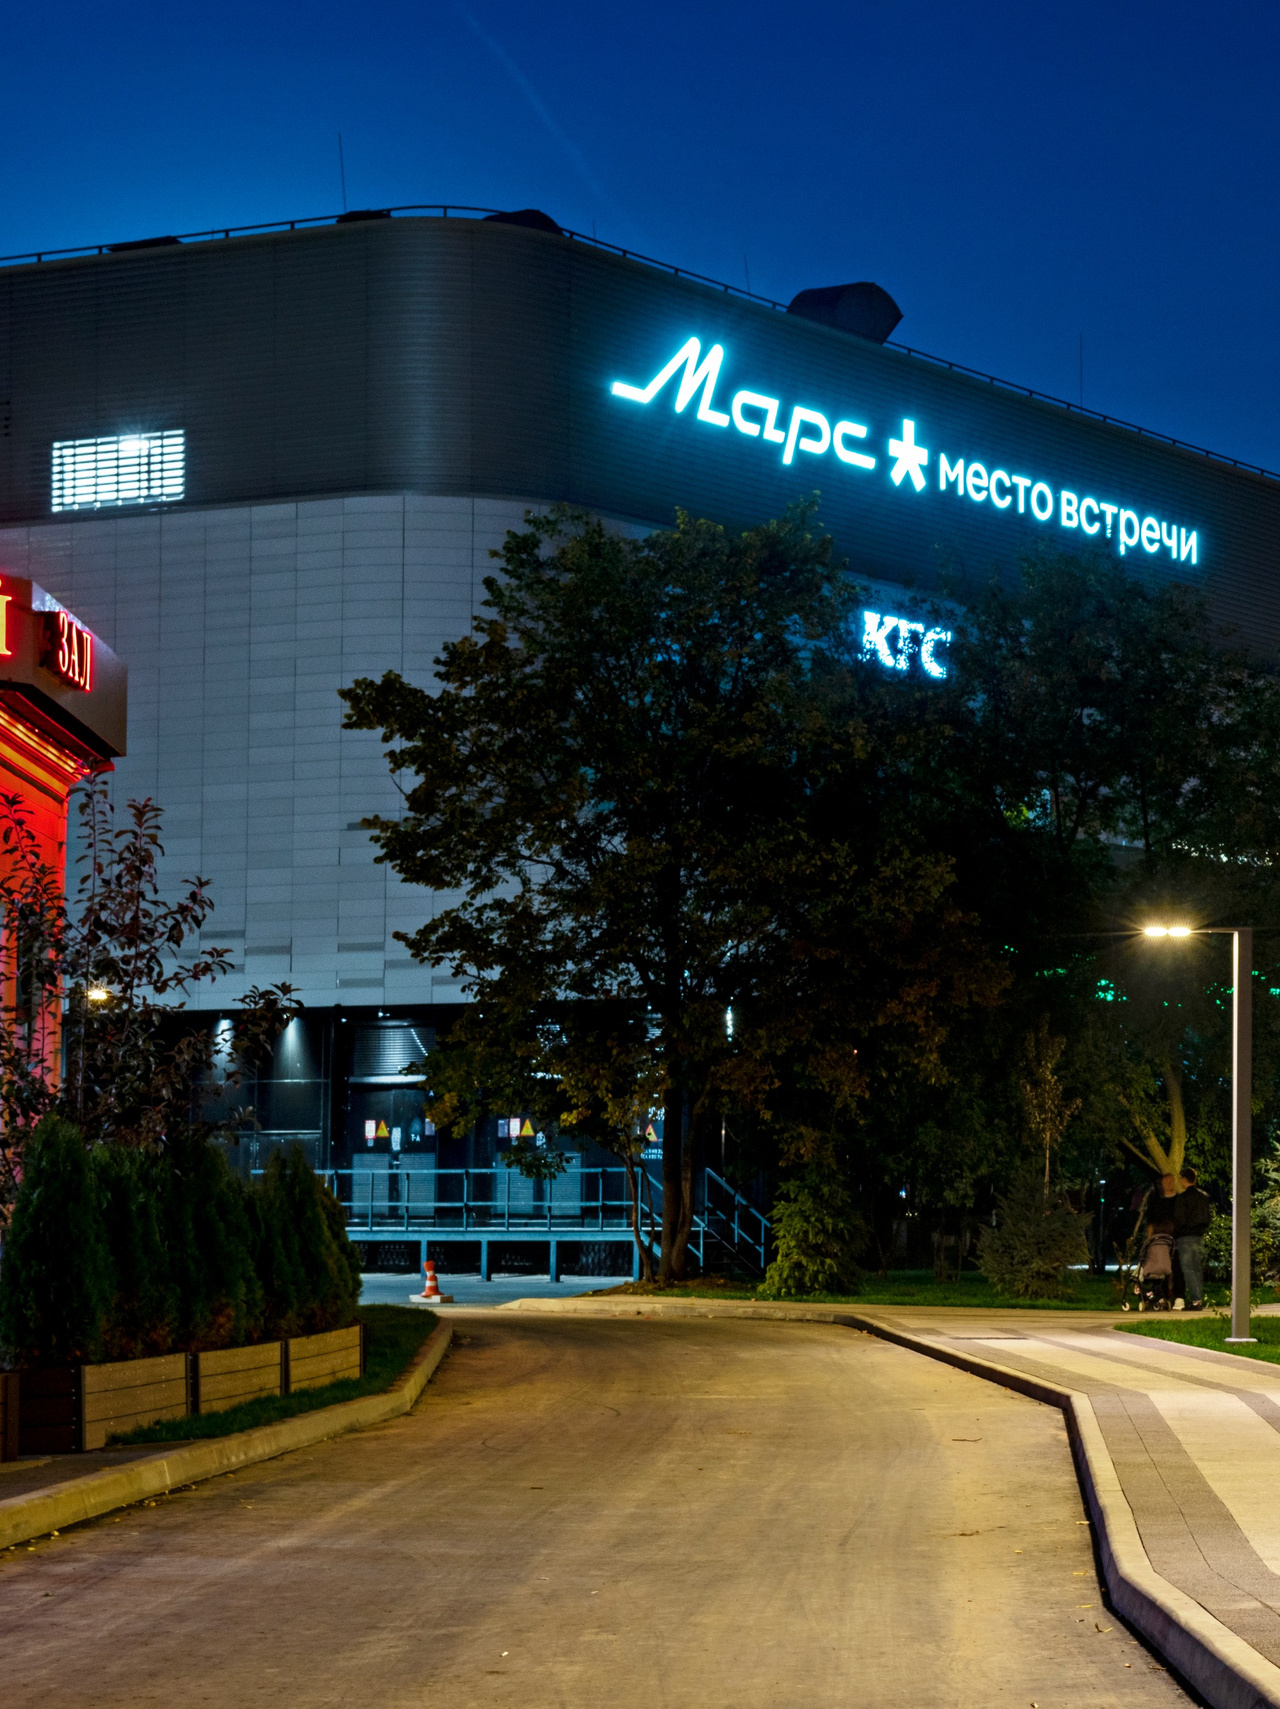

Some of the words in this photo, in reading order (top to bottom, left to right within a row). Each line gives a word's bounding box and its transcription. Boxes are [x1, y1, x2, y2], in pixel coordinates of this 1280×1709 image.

[609, 334, 878, 471] Марс
[938, 452, 1055, 522] место
[1060, 489, 1199, 566] встречи
[58, 610, 93, 692] ЗАЛ
